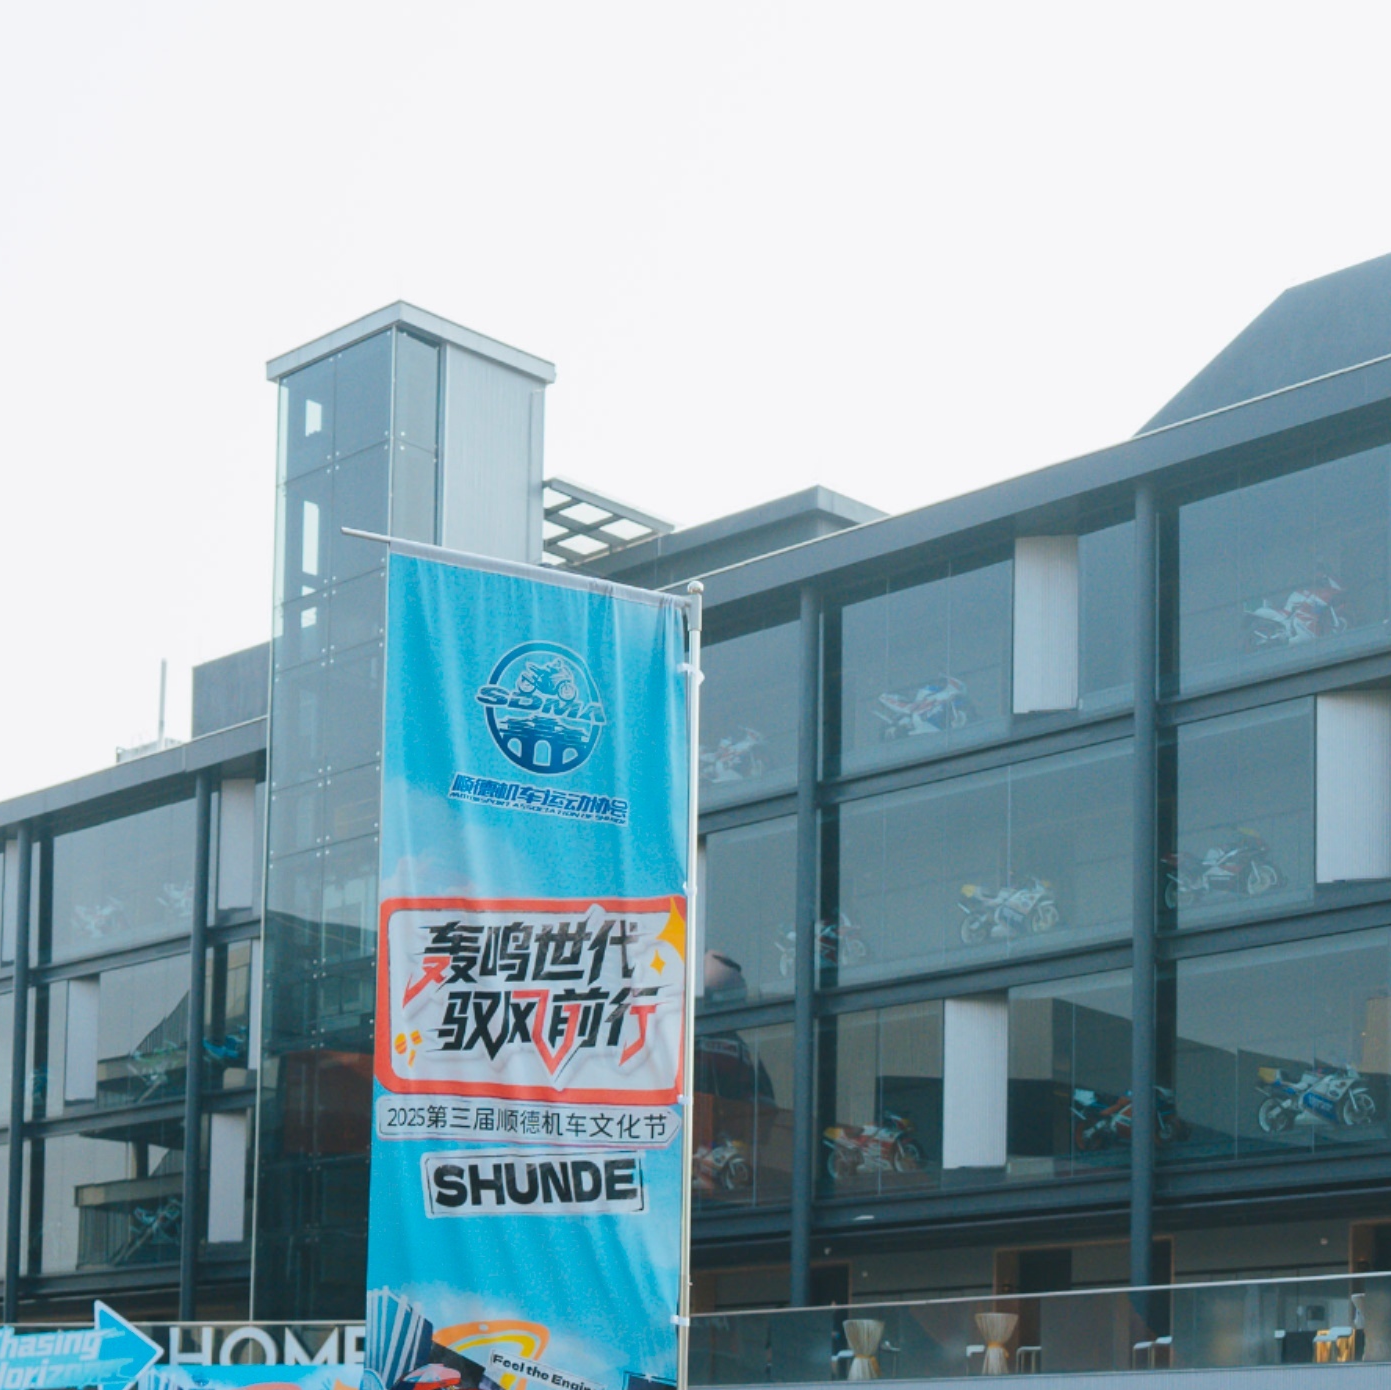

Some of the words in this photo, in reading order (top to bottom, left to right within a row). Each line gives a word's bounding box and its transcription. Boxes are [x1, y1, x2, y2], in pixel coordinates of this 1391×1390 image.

[452, 775, 629, 818] 顺德机车运动协会
[403, 919, 642, 1000] 轰鸣世代
[430, 986, 666, 1074] 驭风前行
[387, 1104, 668, 1140] 2025第三届顺德机车文化节
[433, 1157, 639, 1208] SHUNDE
[492, 1353, 525, 1373] Feel
[525, 1364, 550, 1381] the
